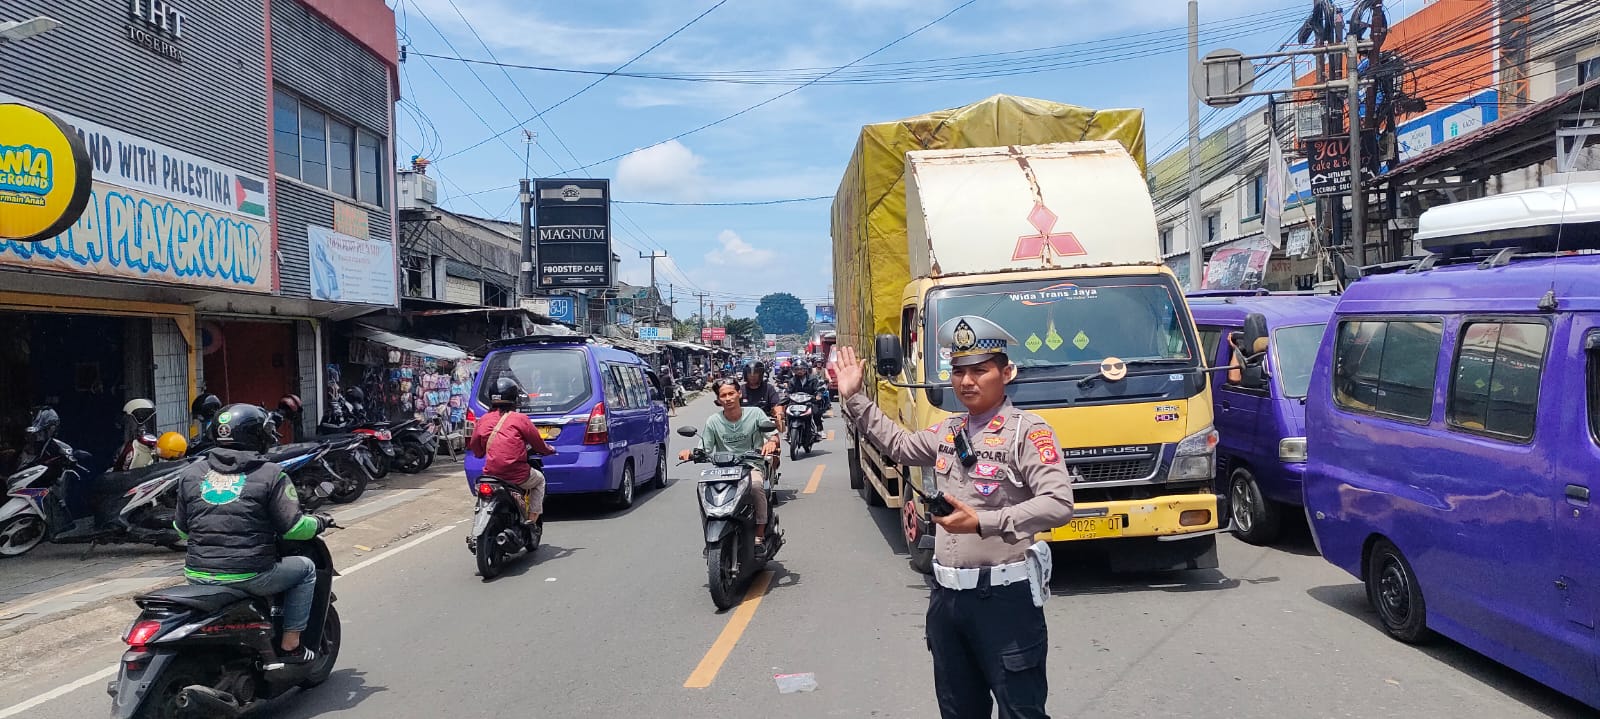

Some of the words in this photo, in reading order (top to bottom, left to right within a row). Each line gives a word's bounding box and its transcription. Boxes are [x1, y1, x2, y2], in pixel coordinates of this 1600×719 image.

[129, 26, 184, 62] TOSERBA
[0, 149, 47, 178] NIA
[118, 141, 157, 185] WITH
[163, 155, 231, 205] PALESTINA
[25, 197, 45, 205] Anak
[105, 191, 260, 284] PLAYGROUND
[540, 229, 605, 240] MAGNUM
[543, 265, 582, 274] FOODSTEP
[584, 265, 604, 273] CAFE
[1009, 293, 1037, 301] Wida
[1040, 290, 1070, 299] Trans
[1073, 288, 1097, 297] Jaya
[647, 327, 658, 337] BRI
[975, 450, 1008, 463] POLRI
[1102, 446, 1149, 454] FUSO
[1070, 519, 1096, 532] 9026
